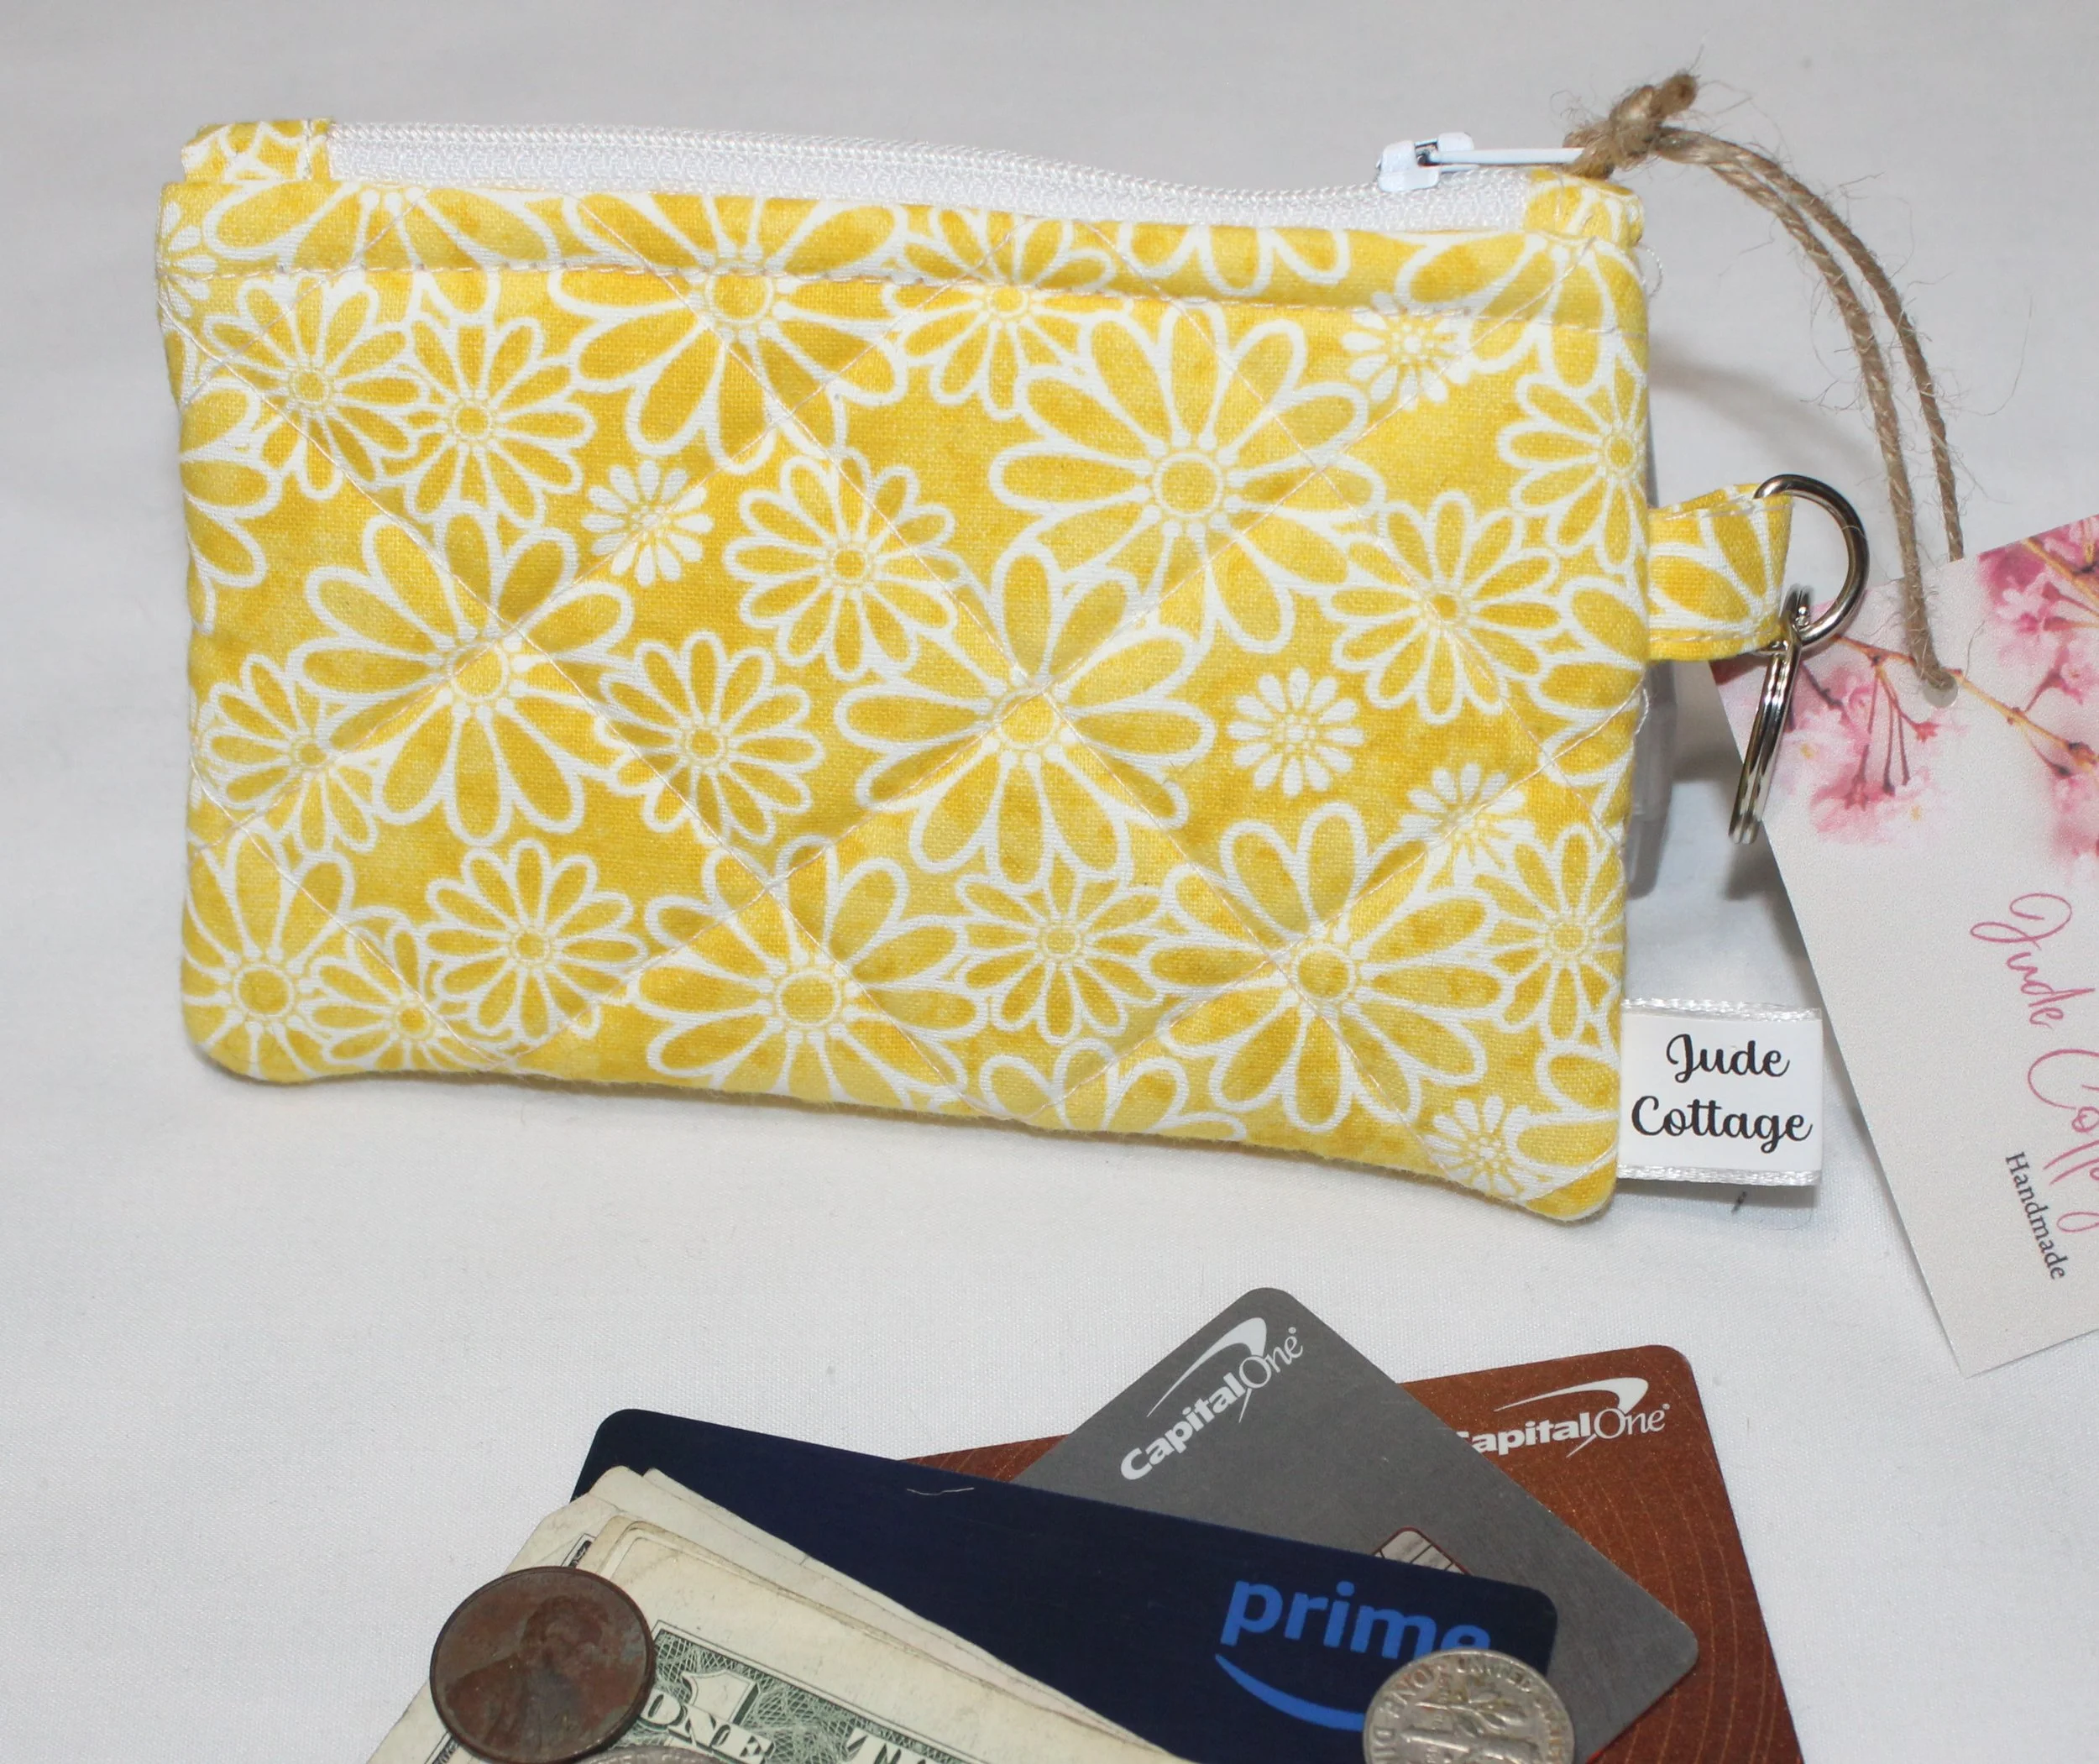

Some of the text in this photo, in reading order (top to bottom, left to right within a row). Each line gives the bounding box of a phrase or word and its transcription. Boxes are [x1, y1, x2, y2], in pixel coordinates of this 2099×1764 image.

[1970, 892, 2096, 1029] Jude
[1666, 1034, 1790, 1083] Jude
[1631, 1095, 1813, 1154] Cottage
[2005, 1151, 2069, 1280] Handmade
[1120, 1335, 1303, 1480] Capital One
[1594, 1406, 1667, 1439] One
[639, 1688, 774, 1764] ONE
